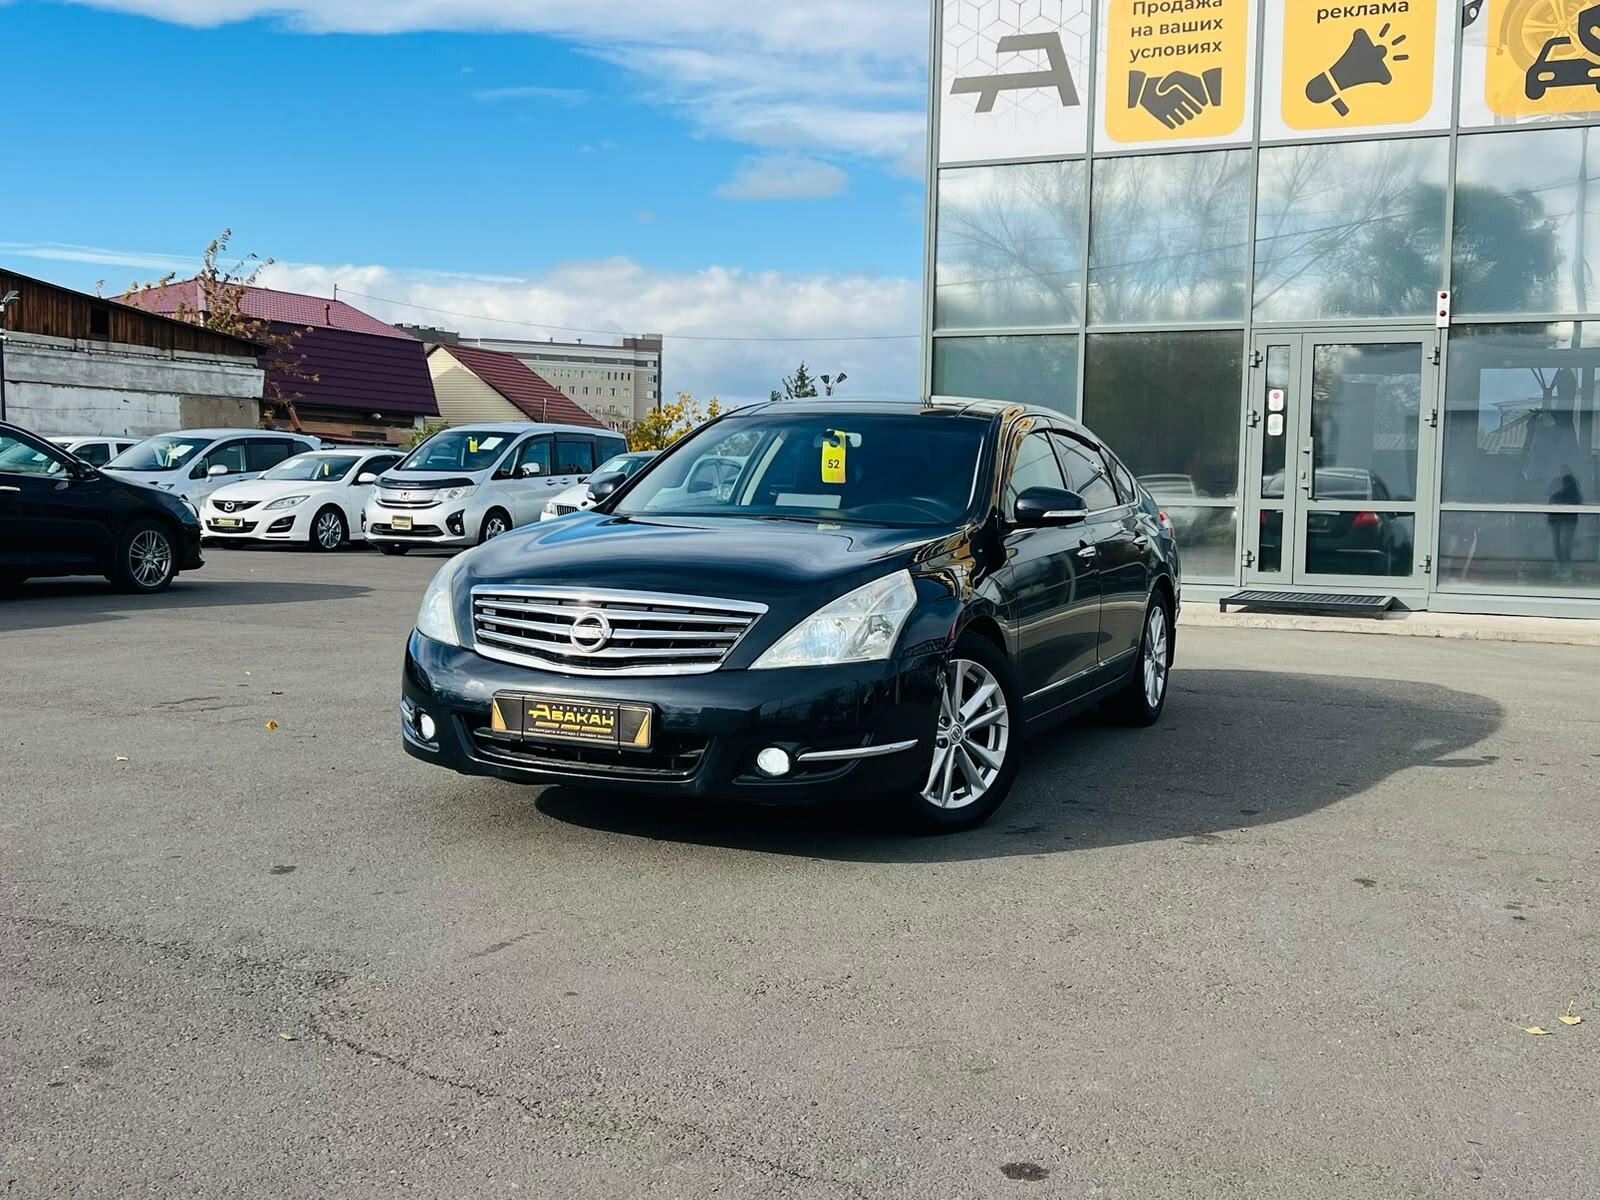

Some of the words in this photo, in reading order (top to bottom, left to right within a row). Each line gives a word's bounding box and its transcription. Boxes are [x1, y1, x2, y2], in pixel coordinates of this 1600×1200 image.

[1133, 0, 1222, 17] Продажа
[1317, 1, 1409, 24] реклама
[1131, 26, 1153, 37] на
[1160, 19, 1223, 35] ваших
[1130, 41, 1222, 63] условиях
[827, 459, 840, 469] 52
